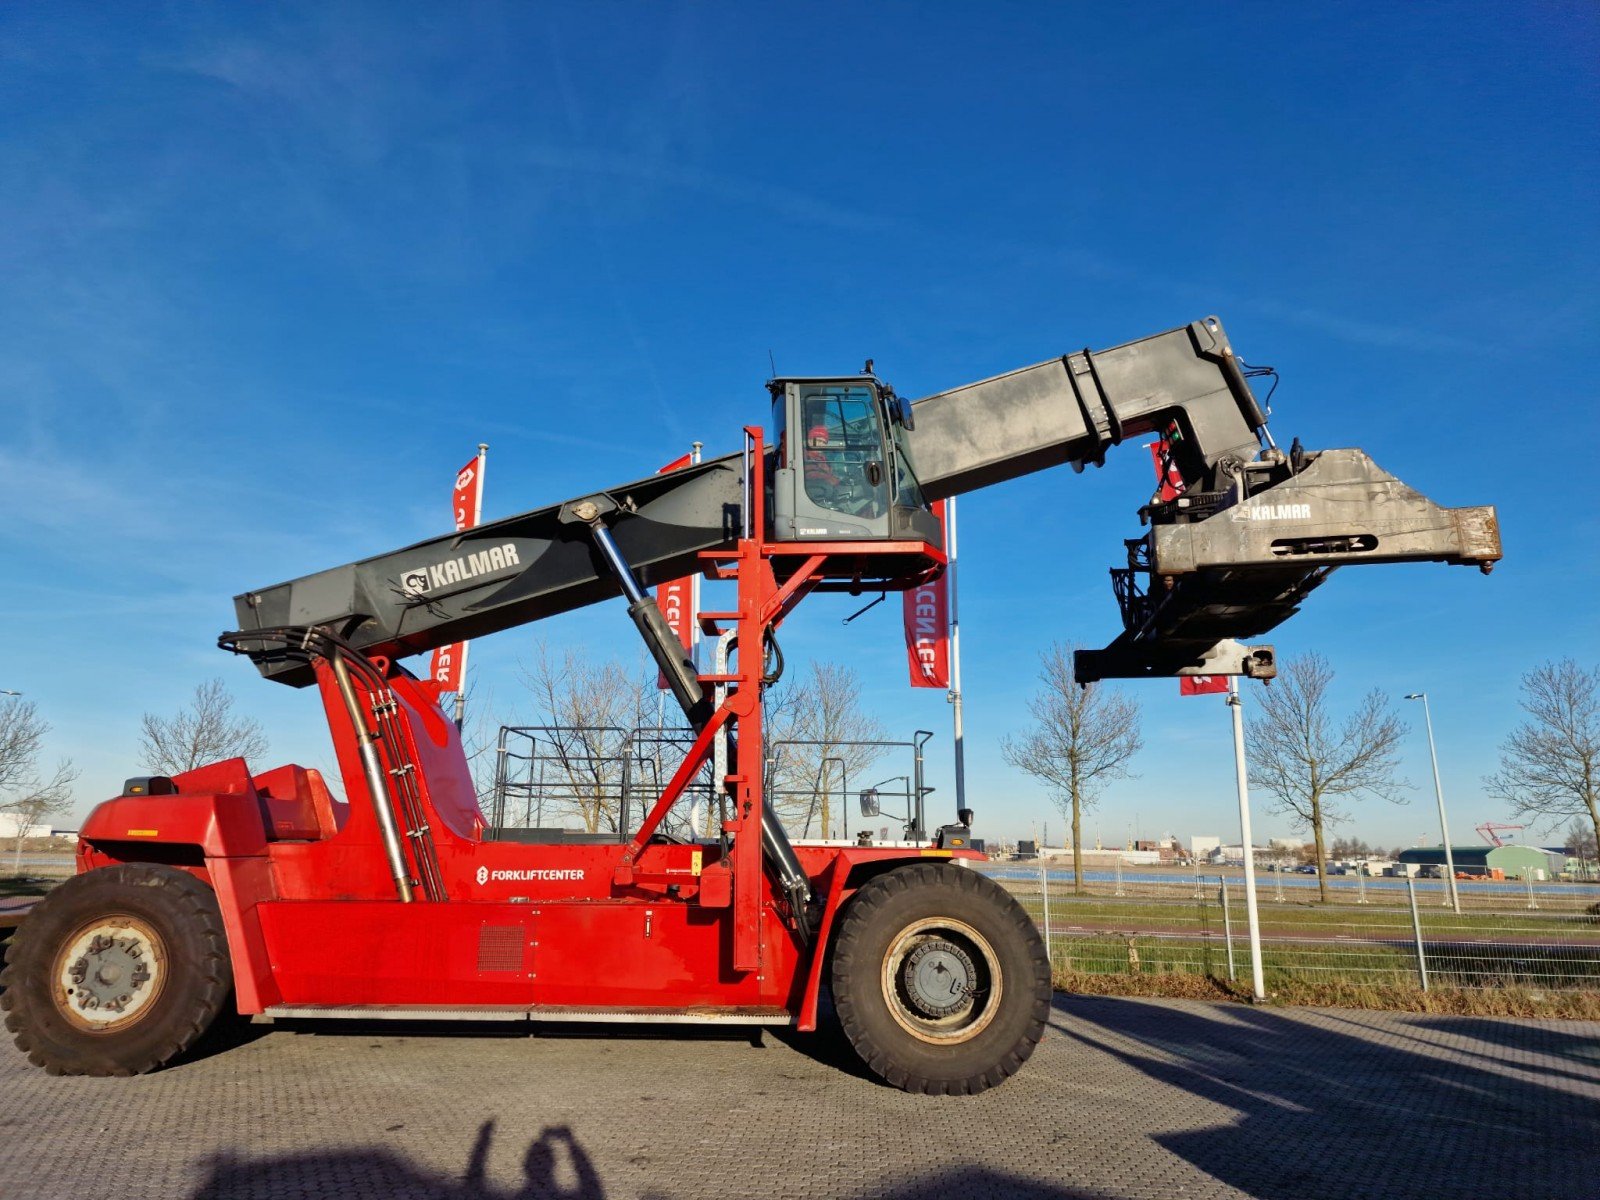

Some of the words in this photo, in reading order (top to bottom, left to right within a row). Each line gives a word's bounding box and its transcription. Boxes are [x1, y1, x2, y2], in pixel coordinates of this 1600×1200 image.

[1251, 503, 1312, 521] KALMAR
[429, 543, 520, 589] KALMAR
[491, 869, 585, 881] FORKLIFTCENTER
